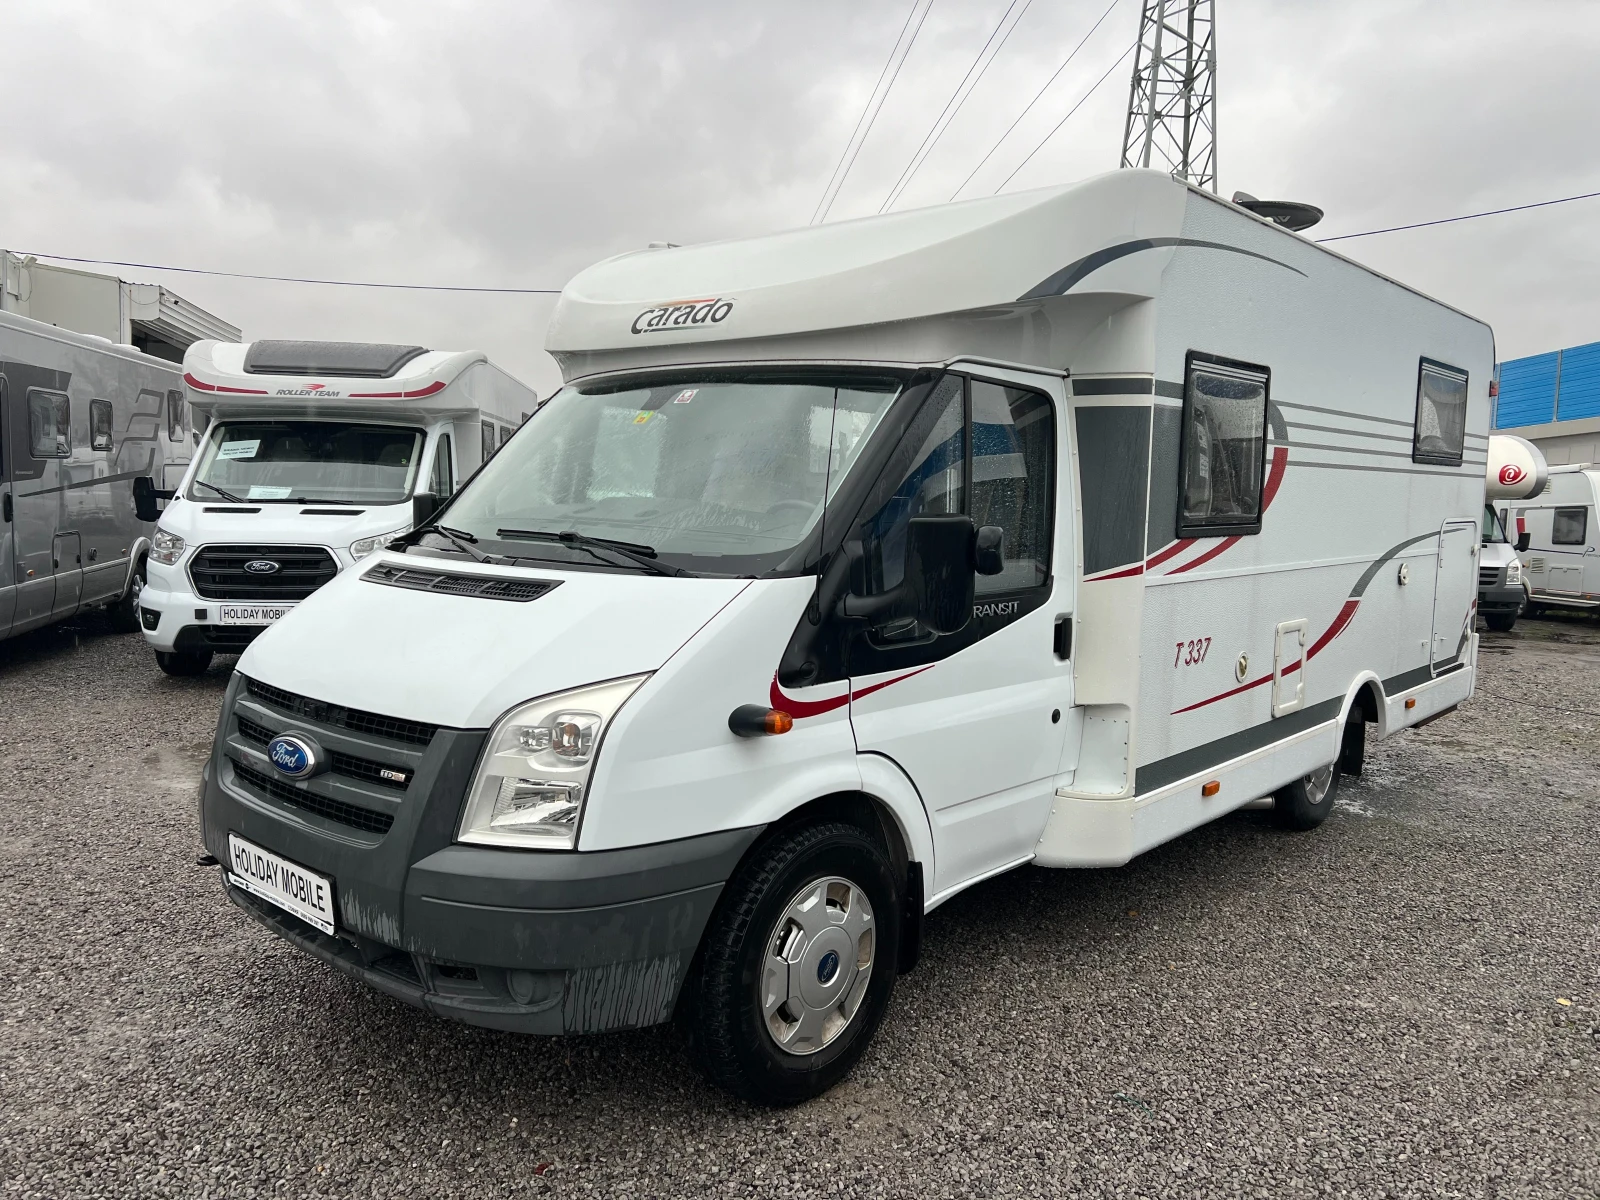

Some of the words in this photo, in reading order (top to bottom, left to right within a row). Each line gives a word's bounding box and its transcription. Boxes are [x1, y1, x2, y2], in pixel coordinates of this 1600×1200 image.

[276, 389, 312, 397] ROLLER
[314, 390, 340, 398] TEAM
[223, 608, 260, 619] HOLIDAY
[973, 601, 1020, 619] RANSIT
[1174, 642, 1185, 669] T
[1184, 637, 1212, 667] 337
[271, 742, 299, 768] Ford
[233, 843, 279, 889] HOLIDAY
[281, 866, 326, 913] MOBILE
